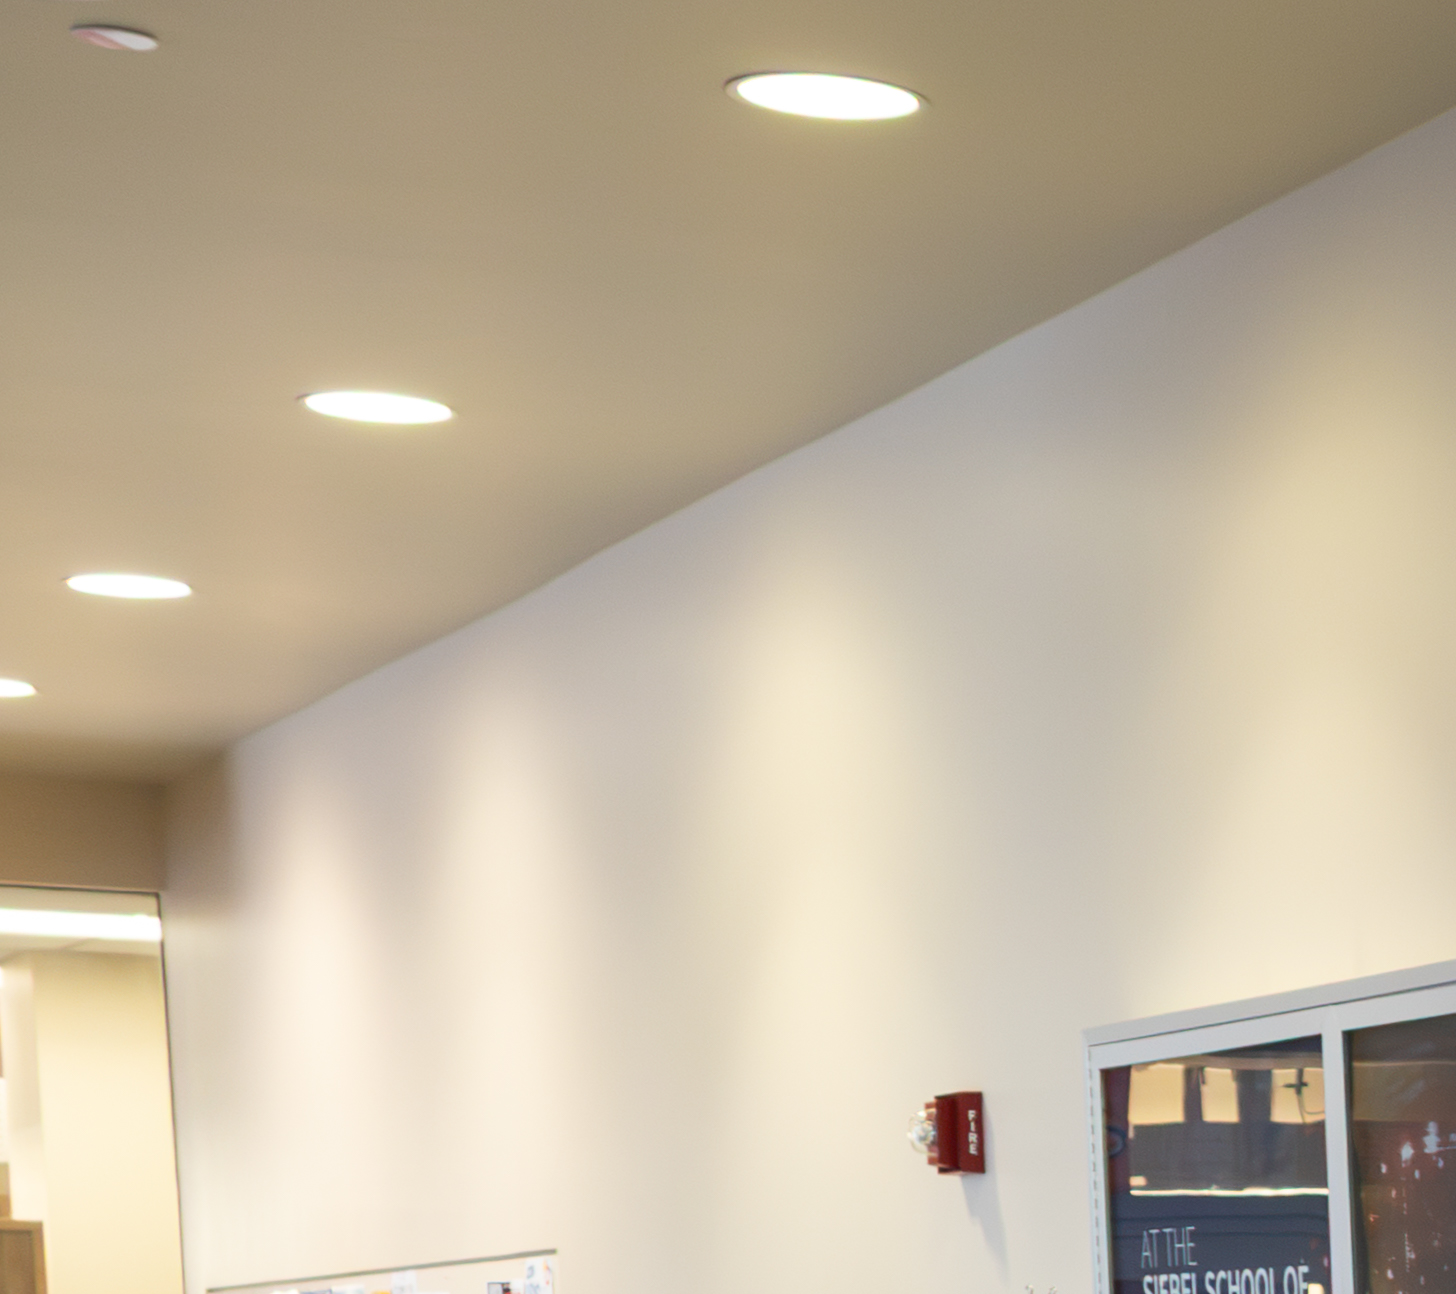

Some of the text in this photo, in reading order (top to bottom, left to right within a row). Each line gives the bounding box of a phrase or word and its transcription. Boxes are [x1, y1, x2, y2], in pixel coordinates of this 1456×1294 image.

[968, 1110, 978, 1156] FIRE
[1141, 1226, 1197, 1269] AT THE
